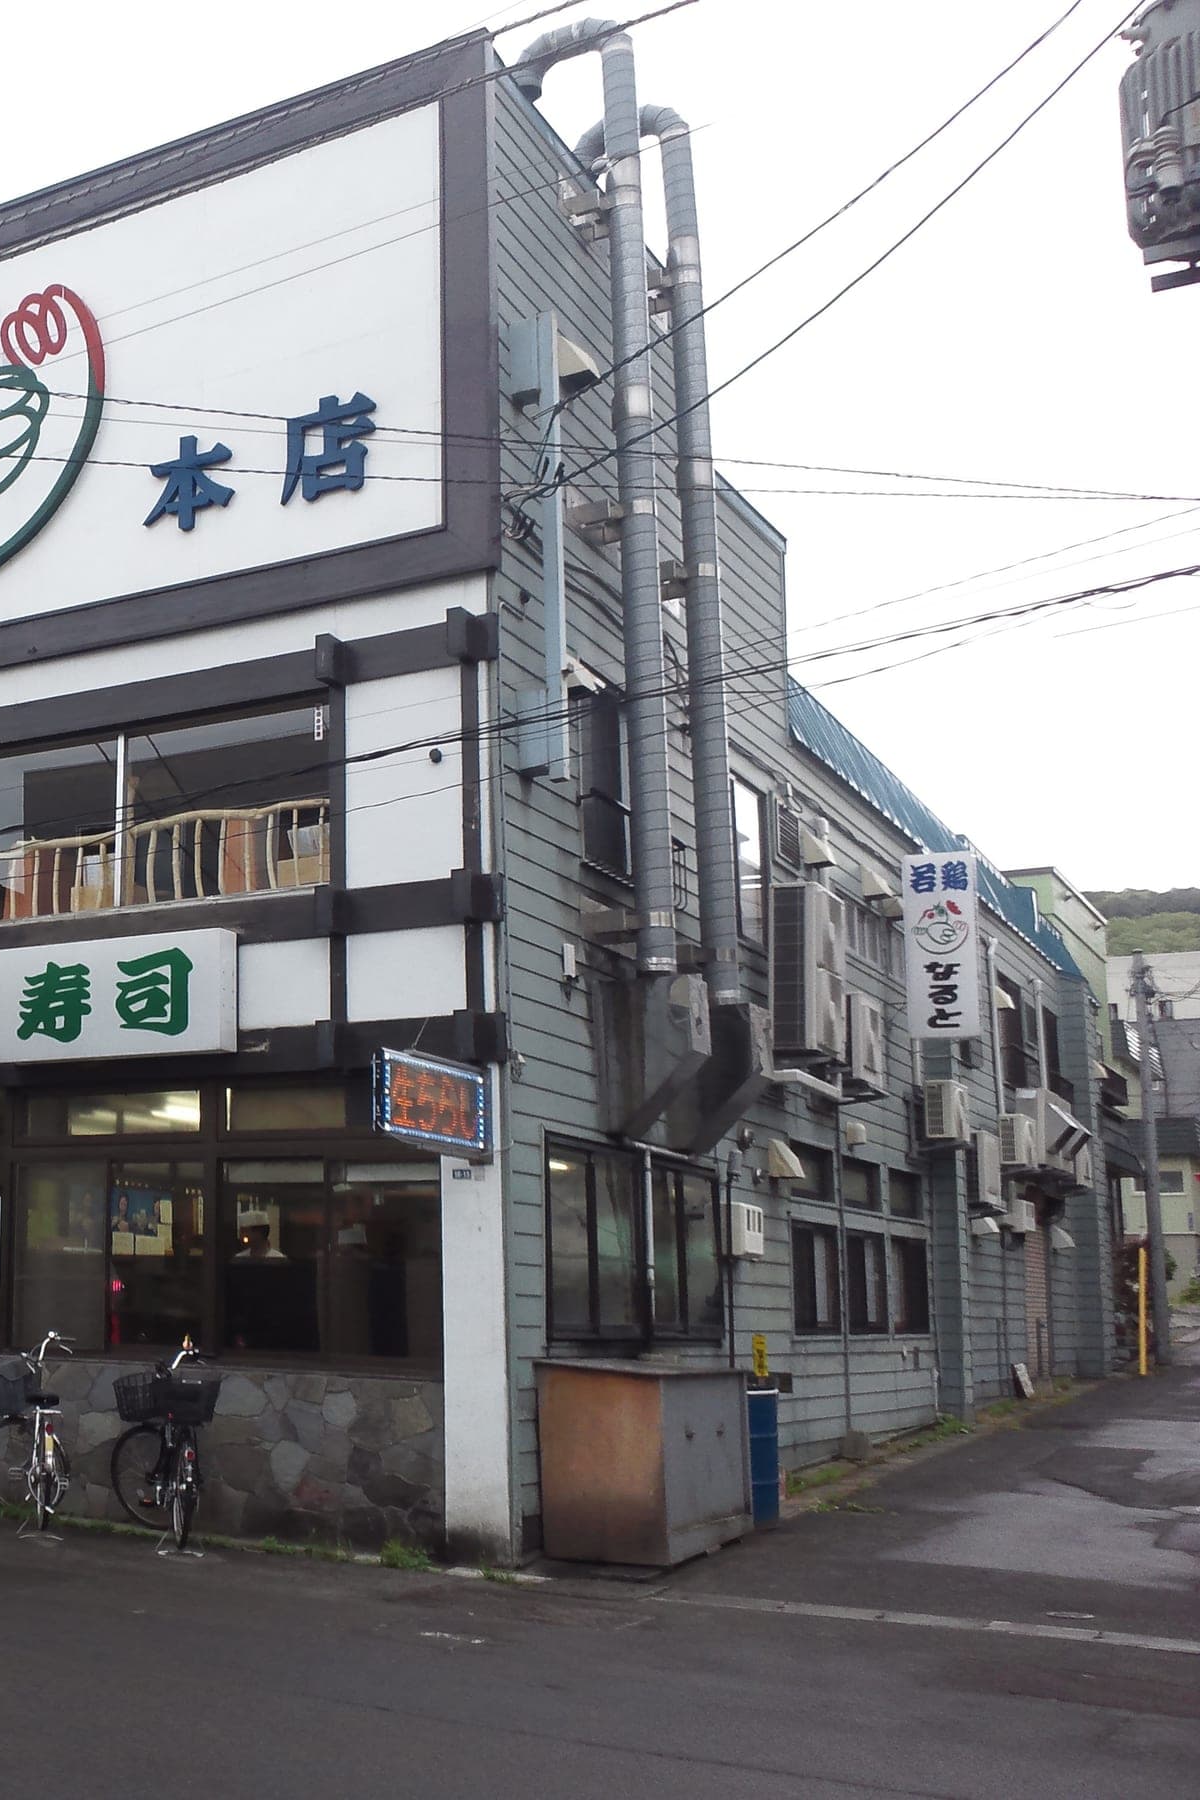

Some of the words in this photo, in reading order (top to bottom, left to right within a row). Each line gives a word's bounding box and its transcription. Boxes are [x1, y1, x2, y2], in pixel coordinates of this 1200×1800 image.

[143, 391, 377, 531] 本店
[910, 860, 968, 894] 若鶏
[16, 946, 194, 1043] 寿司
[923, 961, 962, 1029] なると
